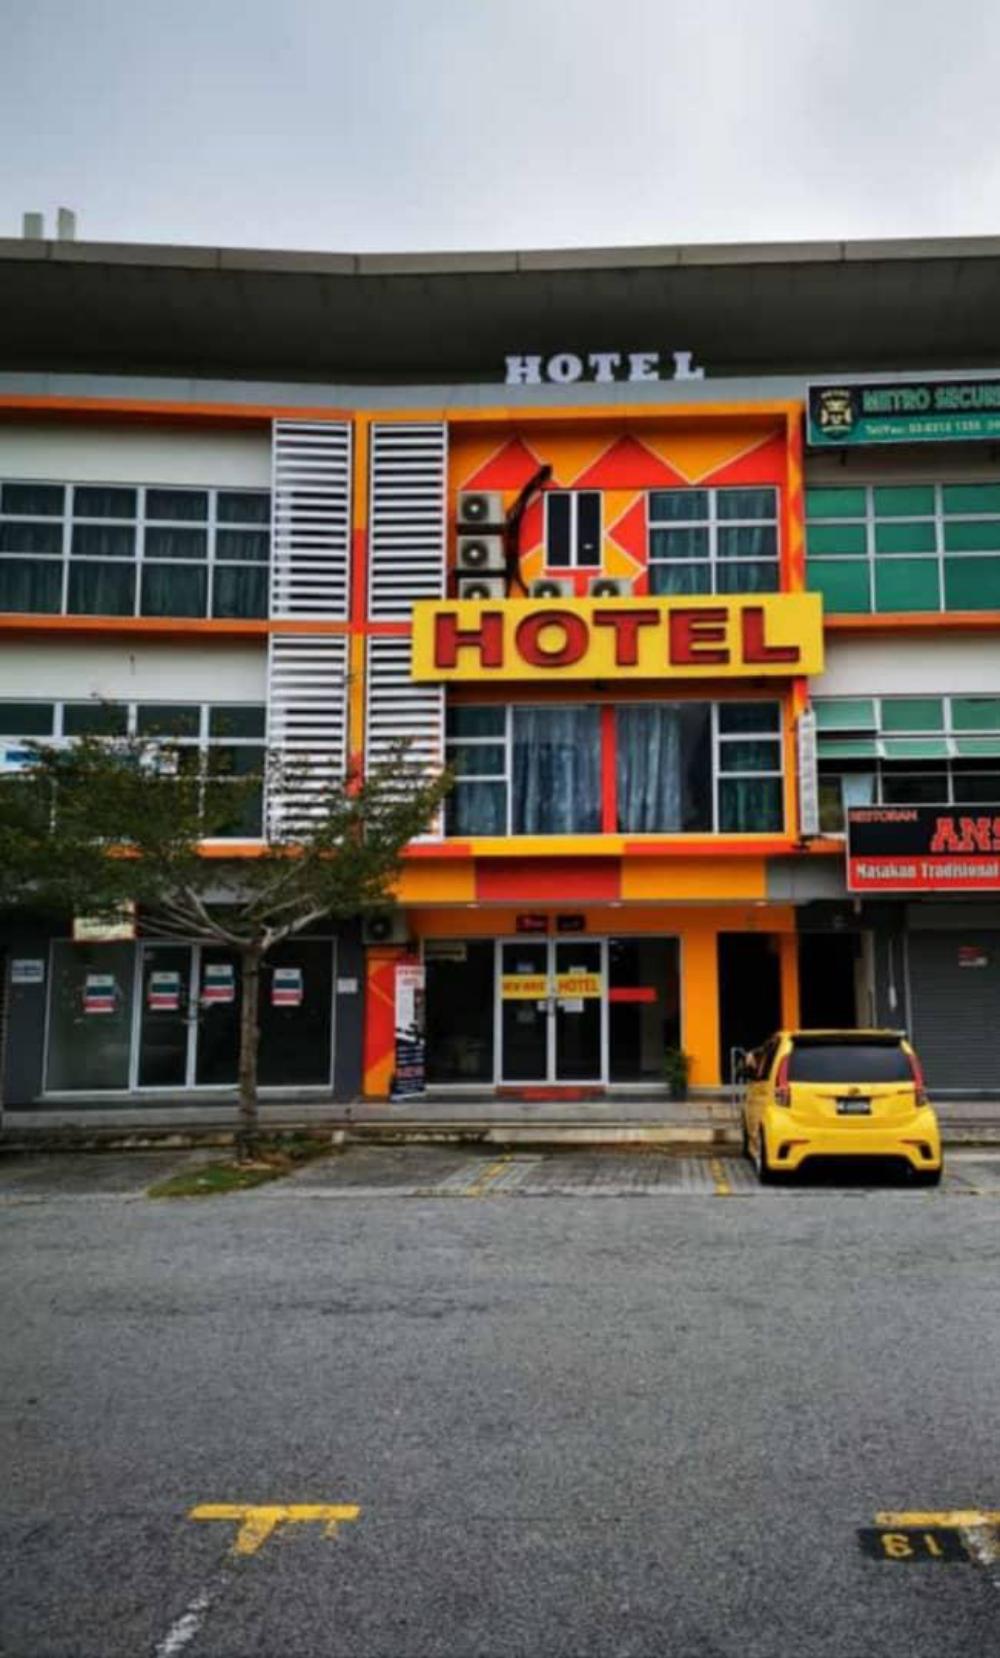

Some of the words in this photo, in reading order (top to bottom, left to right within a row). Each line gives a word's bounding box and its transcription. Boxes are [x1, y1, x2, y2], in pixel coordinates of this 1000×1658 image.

[505, 352, 704, 384] HOTEL
[434, 606, 800, 668] HOTEL
[857, 863, 917, 879] Masakan
[922, 861, 999, 879] Traditional
[559, 978, 599, 993] HOTEL
